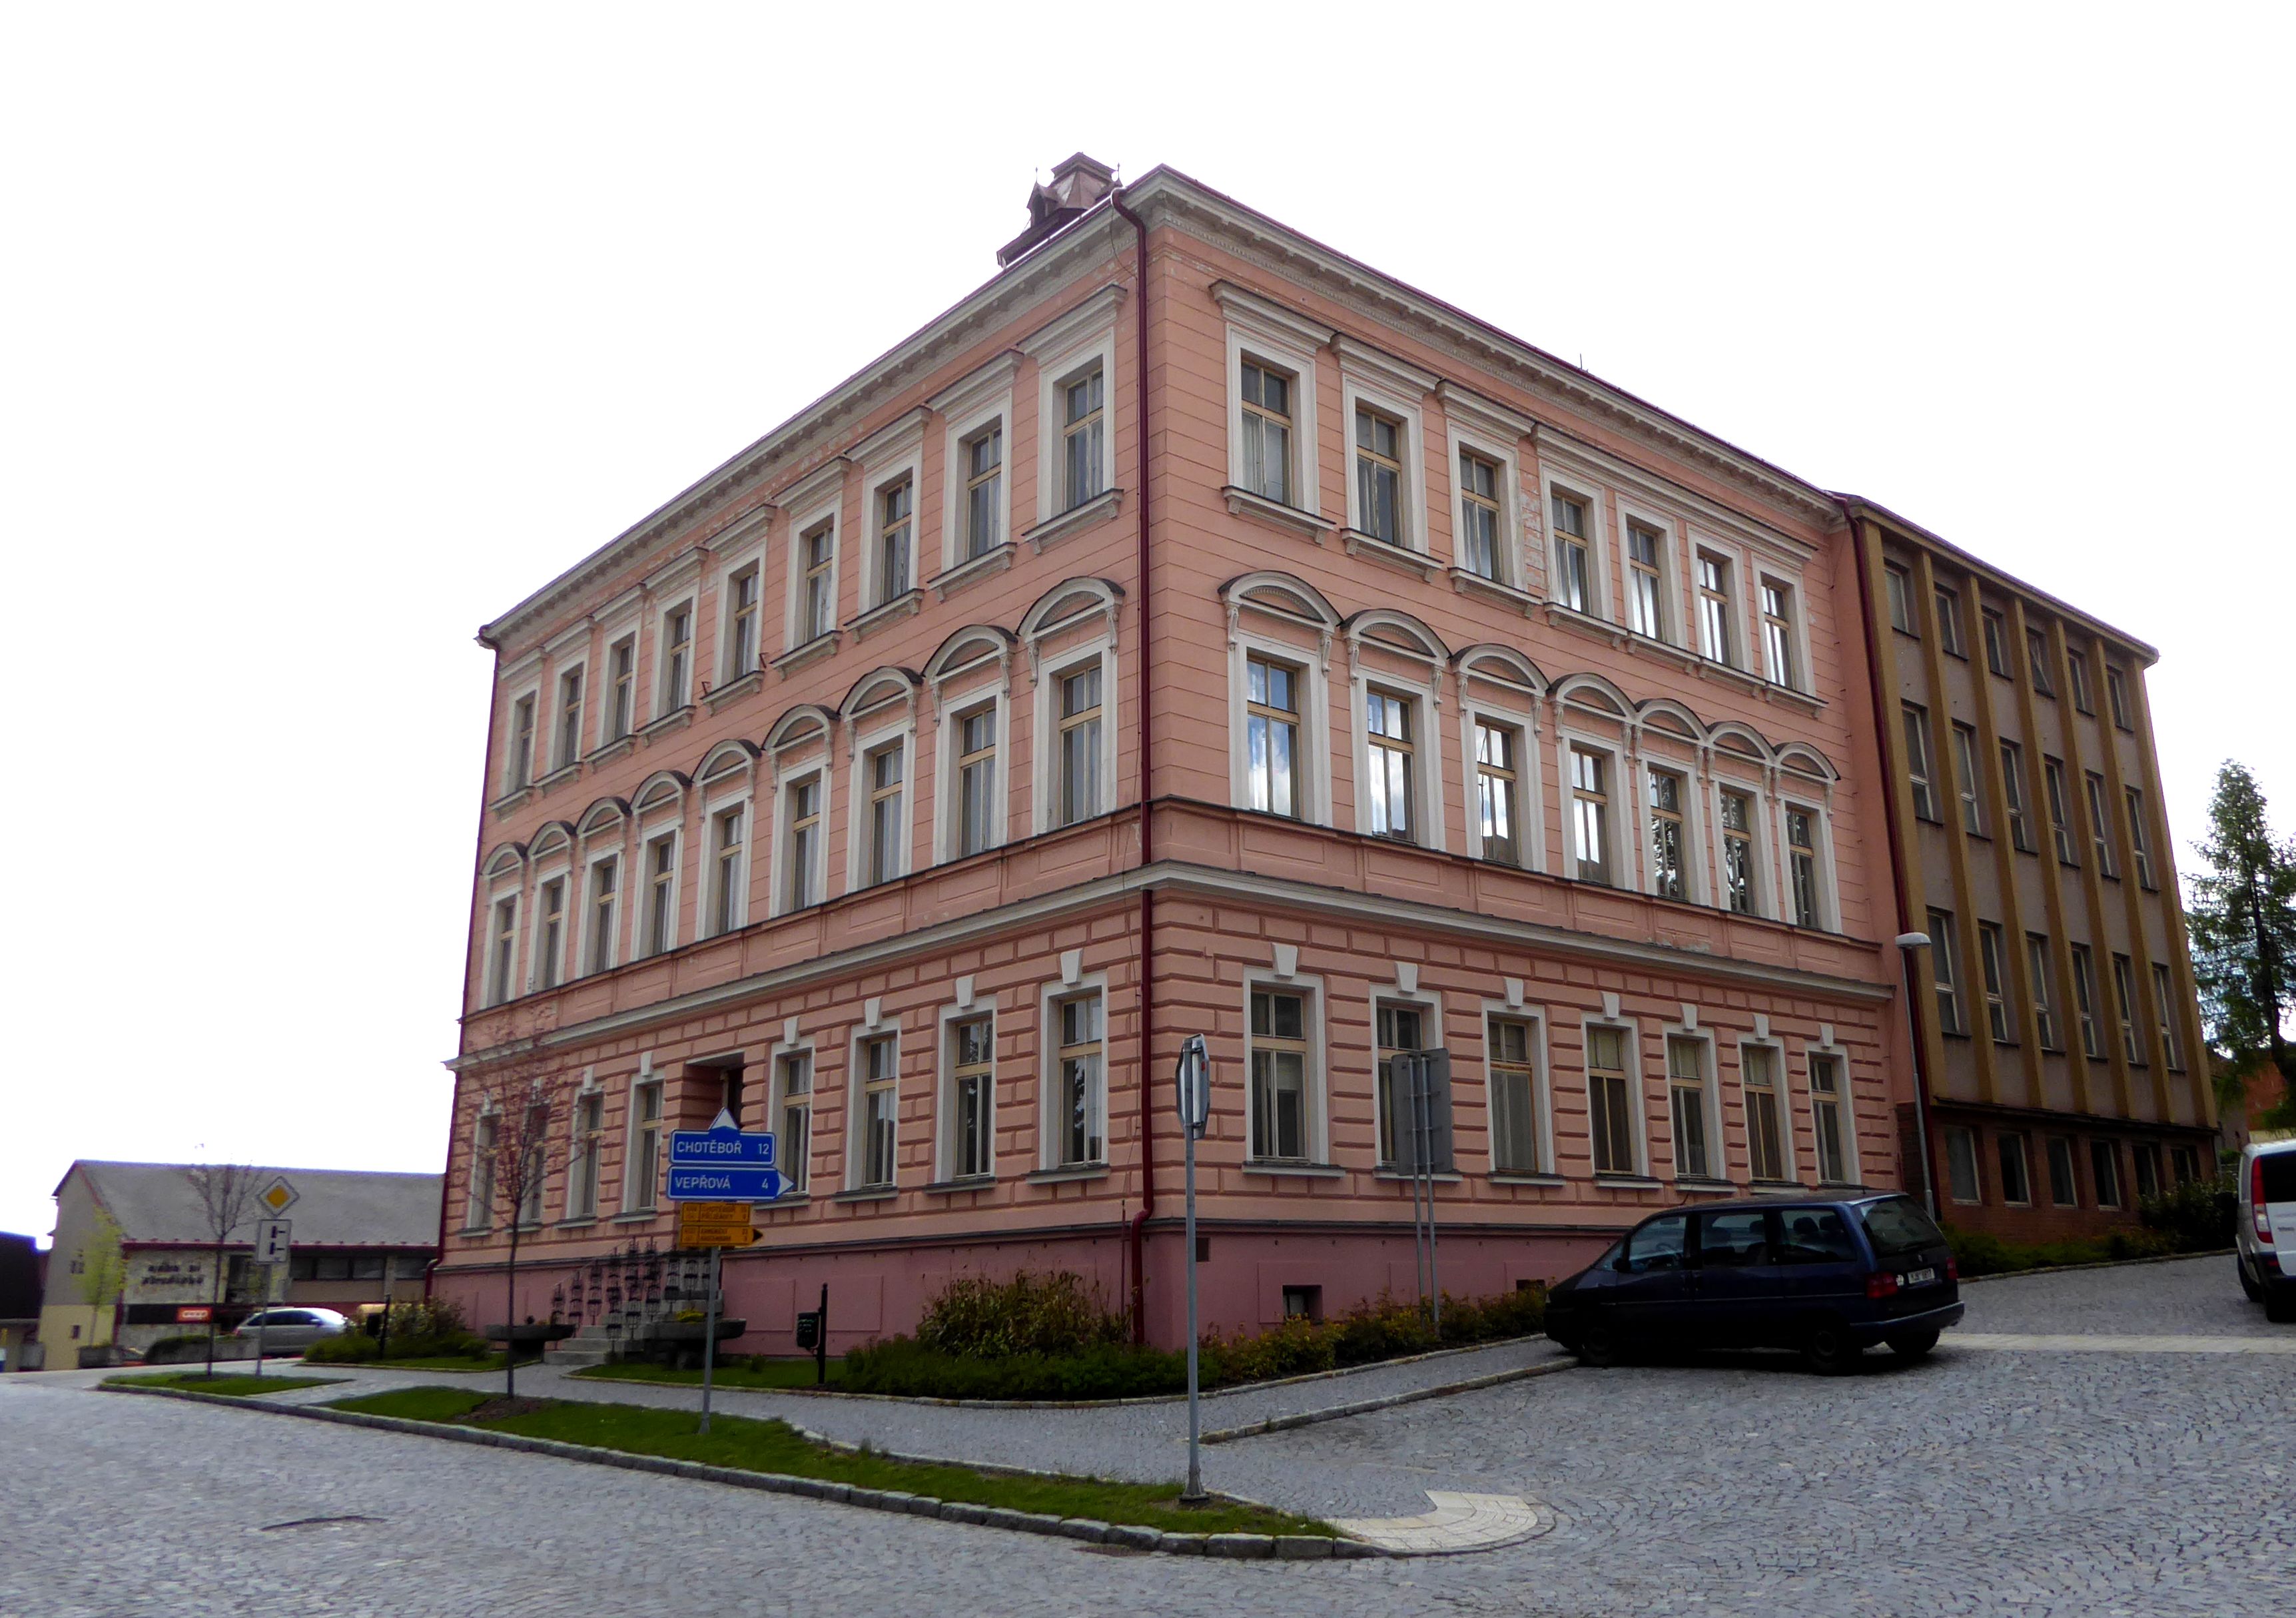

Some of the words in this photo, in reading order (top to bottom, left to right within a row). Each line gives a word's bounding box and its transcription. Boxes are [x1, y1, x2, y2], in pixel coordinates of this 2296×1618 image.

[677, 1140, 742, 1154] CHOTĚBOŘ
[758, 1143, 769, 1154] 12
[675, 1175, 731, 1189] VEPŘOVÁ
[761, 1178, 769, 1189] 4
